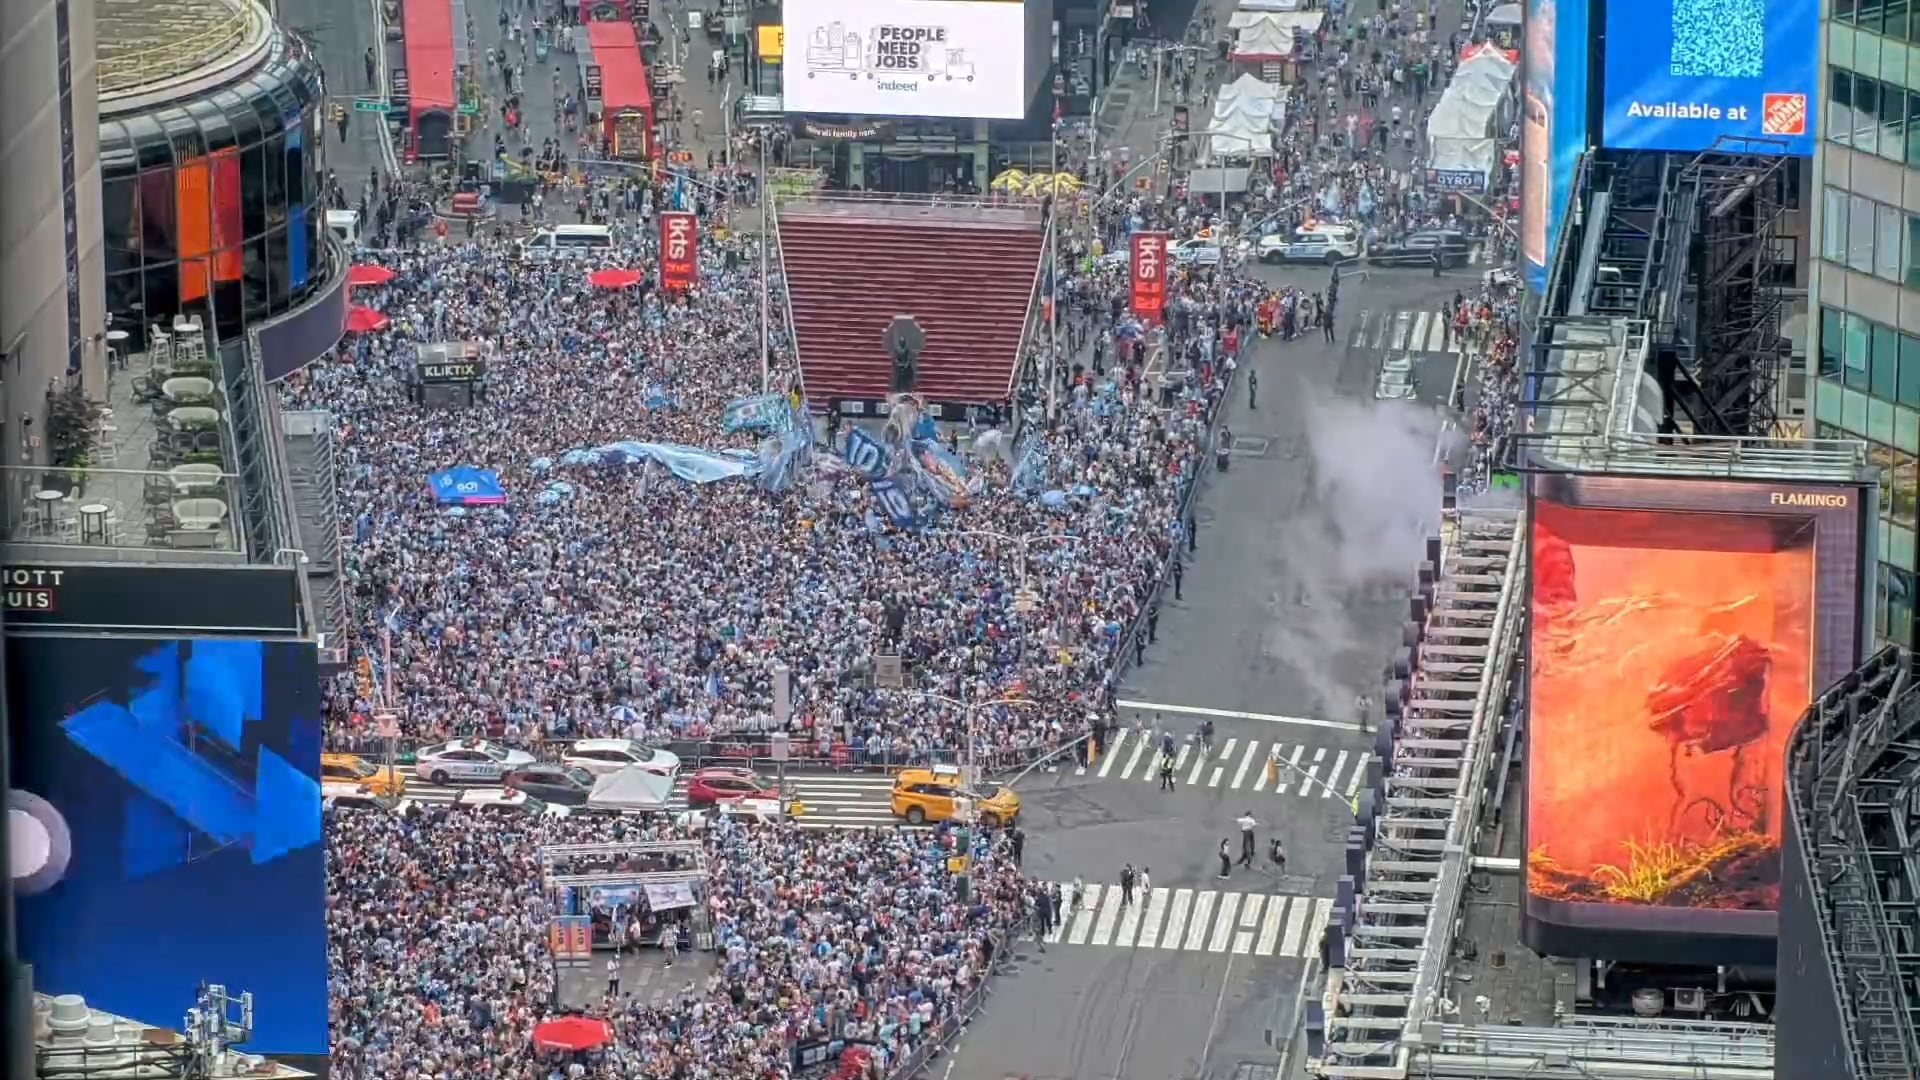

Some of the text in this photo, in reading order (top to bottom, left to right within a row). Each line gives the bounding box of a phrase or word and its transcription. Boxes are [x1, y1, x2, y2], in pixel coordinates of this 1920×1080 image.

[880, 27, 945, 41] PEOPLE
[877, 41, 920, 54] NEED
[875, 56, 918, 68] JOBS
[877, 78, 918, 92] indeed
[1627, 101, 1747, 120] Available at
[669, 218, 690, 259] tkts
[1139, 237, 1160, 279] tkts
[1770, 492, 1848, 508] FLAMINGO
